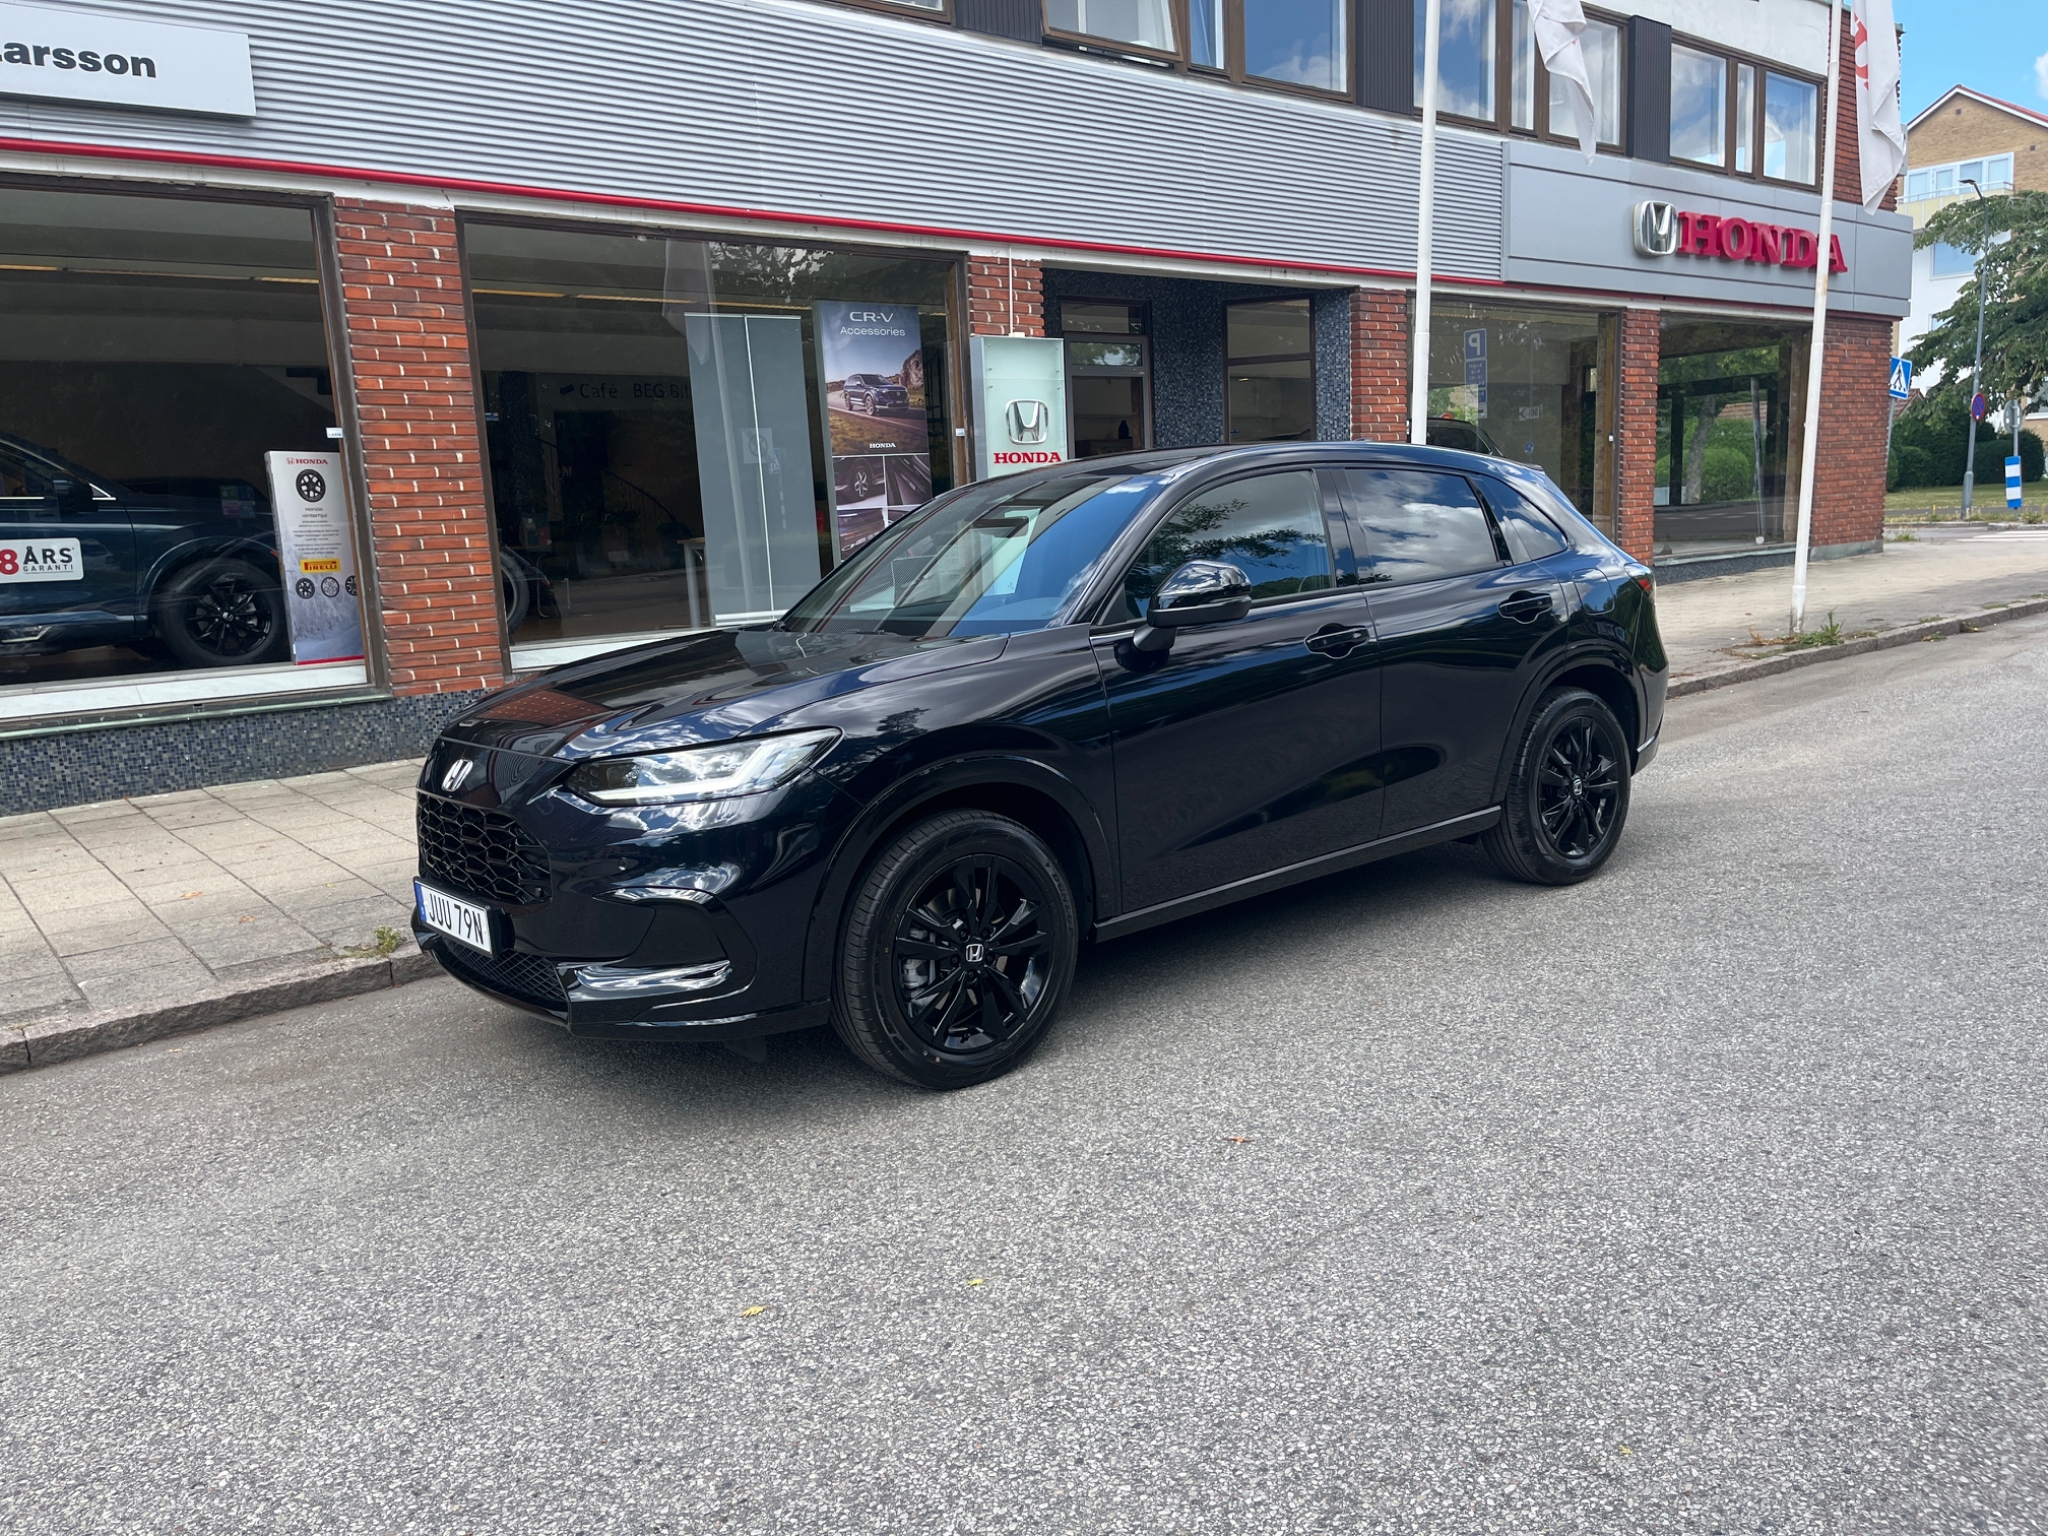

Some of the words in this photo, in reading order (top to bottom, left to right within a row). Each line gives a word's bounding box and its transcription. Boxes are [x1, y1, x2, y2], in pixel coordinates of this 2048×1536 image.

[0, 42, 157, 78] arsson
[1677, 211, 1849, 273] HONDA
[849, 311, 894, 323] CR-V
[840, 326, 906, 337] Accessories
[579, 383, 619, 398] Café
[993, 451, 1062, 464] HONDA
[0, 548, 19, 576] 8
[23, 545, 73, 565] ÅRS
[304, 560, 337, 571] PIRELLI
[23, 564, 74, 572] GARANTI
[429, 893, 452, 930] JUU
[454, 903, 484, 945] 79N
